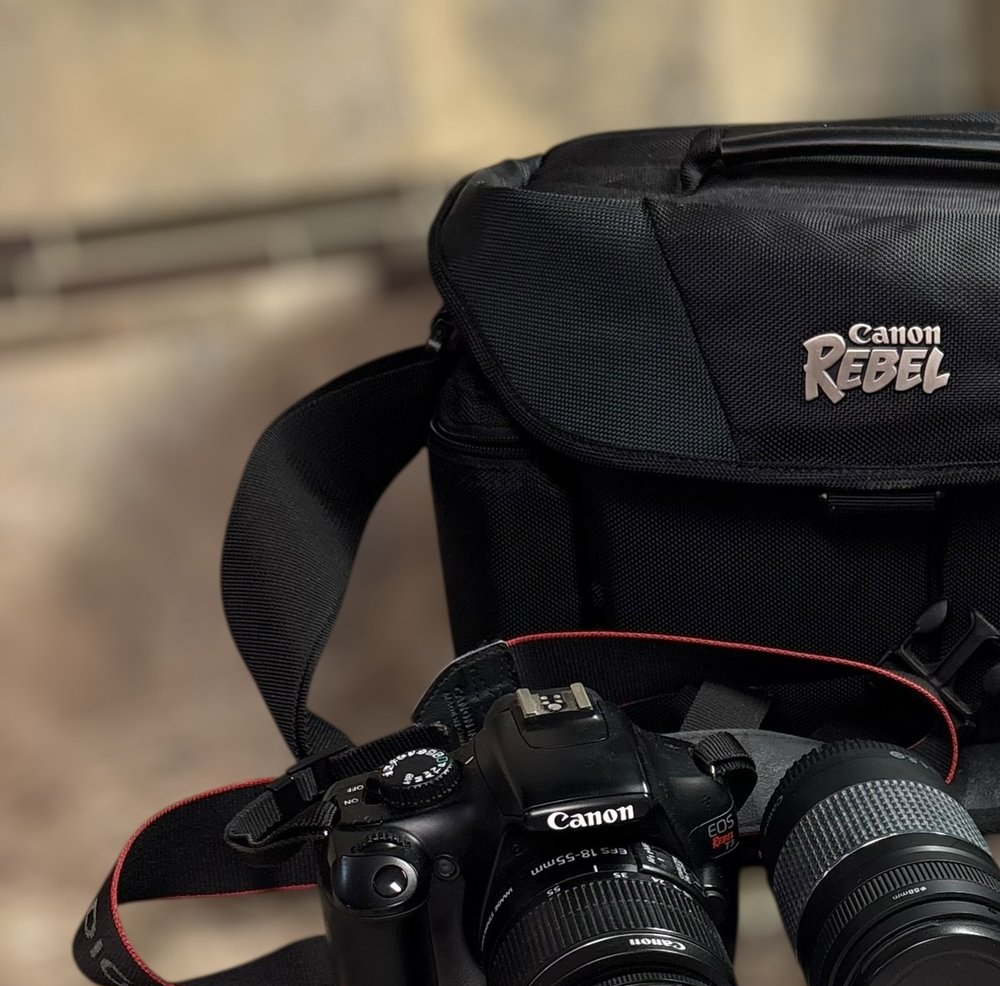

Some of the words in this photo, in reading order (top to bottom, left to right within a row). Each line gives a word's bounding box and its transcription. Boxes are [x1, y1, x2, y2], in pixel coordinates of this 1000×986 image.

[849, 323, 941, 345] Canon
[803, 333, 950, 404] REBEL
[344, 797, 359, 806] ON
[546, 804, 635, 830] Canon
[708, 813, 735, 838] EOS
[530, 848, 598, 876] 18-55mm
[629, 937, 687, 951] Canon
